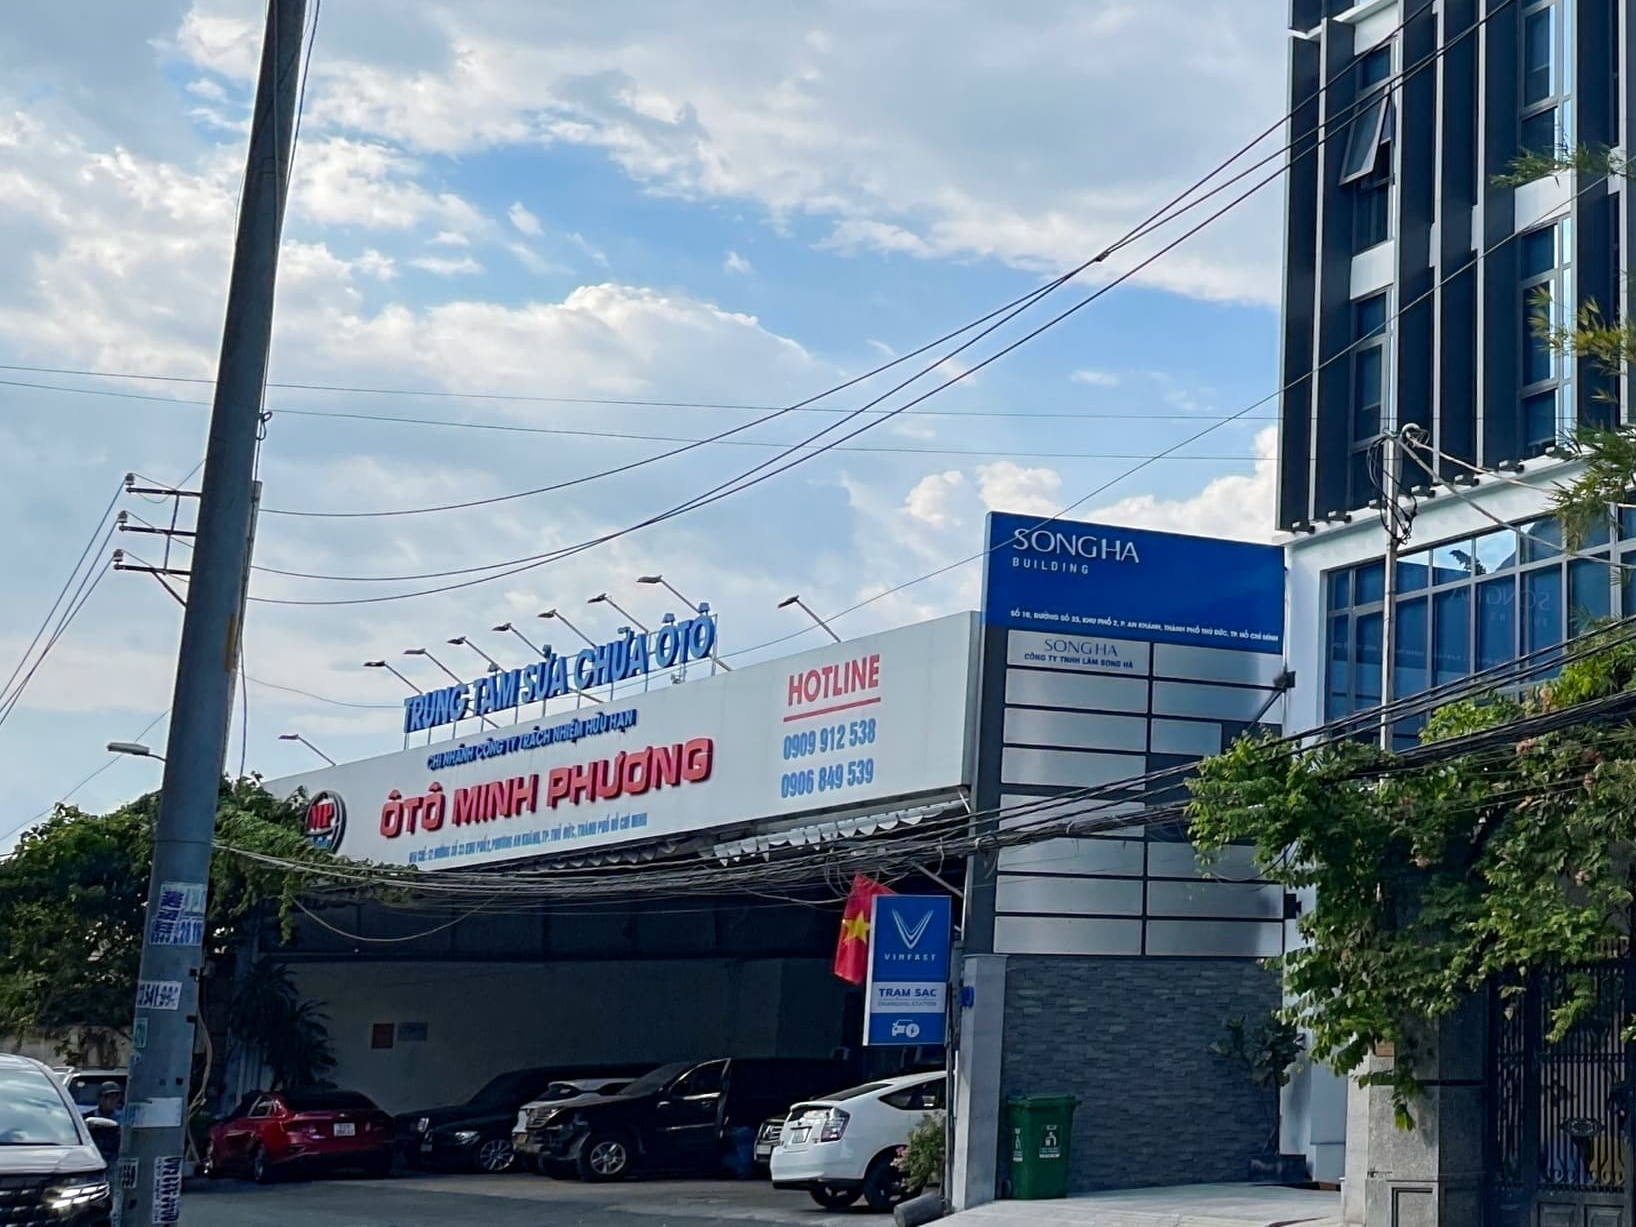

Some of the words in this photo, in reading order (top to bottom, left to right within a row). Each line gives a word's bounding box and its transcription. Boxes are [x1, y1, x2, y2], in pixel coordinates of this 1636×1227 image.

[1012, 557, 1089, 575] BUILDING
[404, 683, 470, 733] TRUNG
[473, 662, 522, 716] TÂM
[521, 644, 568, 702] SỬA
[574, 626, 649, 690] CHỮA
[656, 602, 716, 668] ÔTÔ
[787, 653, 881, 707] HOTLINE
[1024, 652, 1046, 662] CÔNG
[1048, 654, 1058, 663] TY
[1060, 656, 1080, 665] TNHH
[1100, 659, 1121, 668] SONG
[783, 730, 817, 761] 0909
[820, 724, 846, 753] 912
[849, 717, 877, 748] 538
[379, 780, 446, 839] ÔTÔ
[452, 773, 539, 827] MINH
[547, 737, 714, 809] PHƯƠNG
[781, 769, 814, 799] 0906
[818, 763, 844, 792] 849
[847, 757, 874, 786] 539
[884, 953, 937, 962] VINFAST
